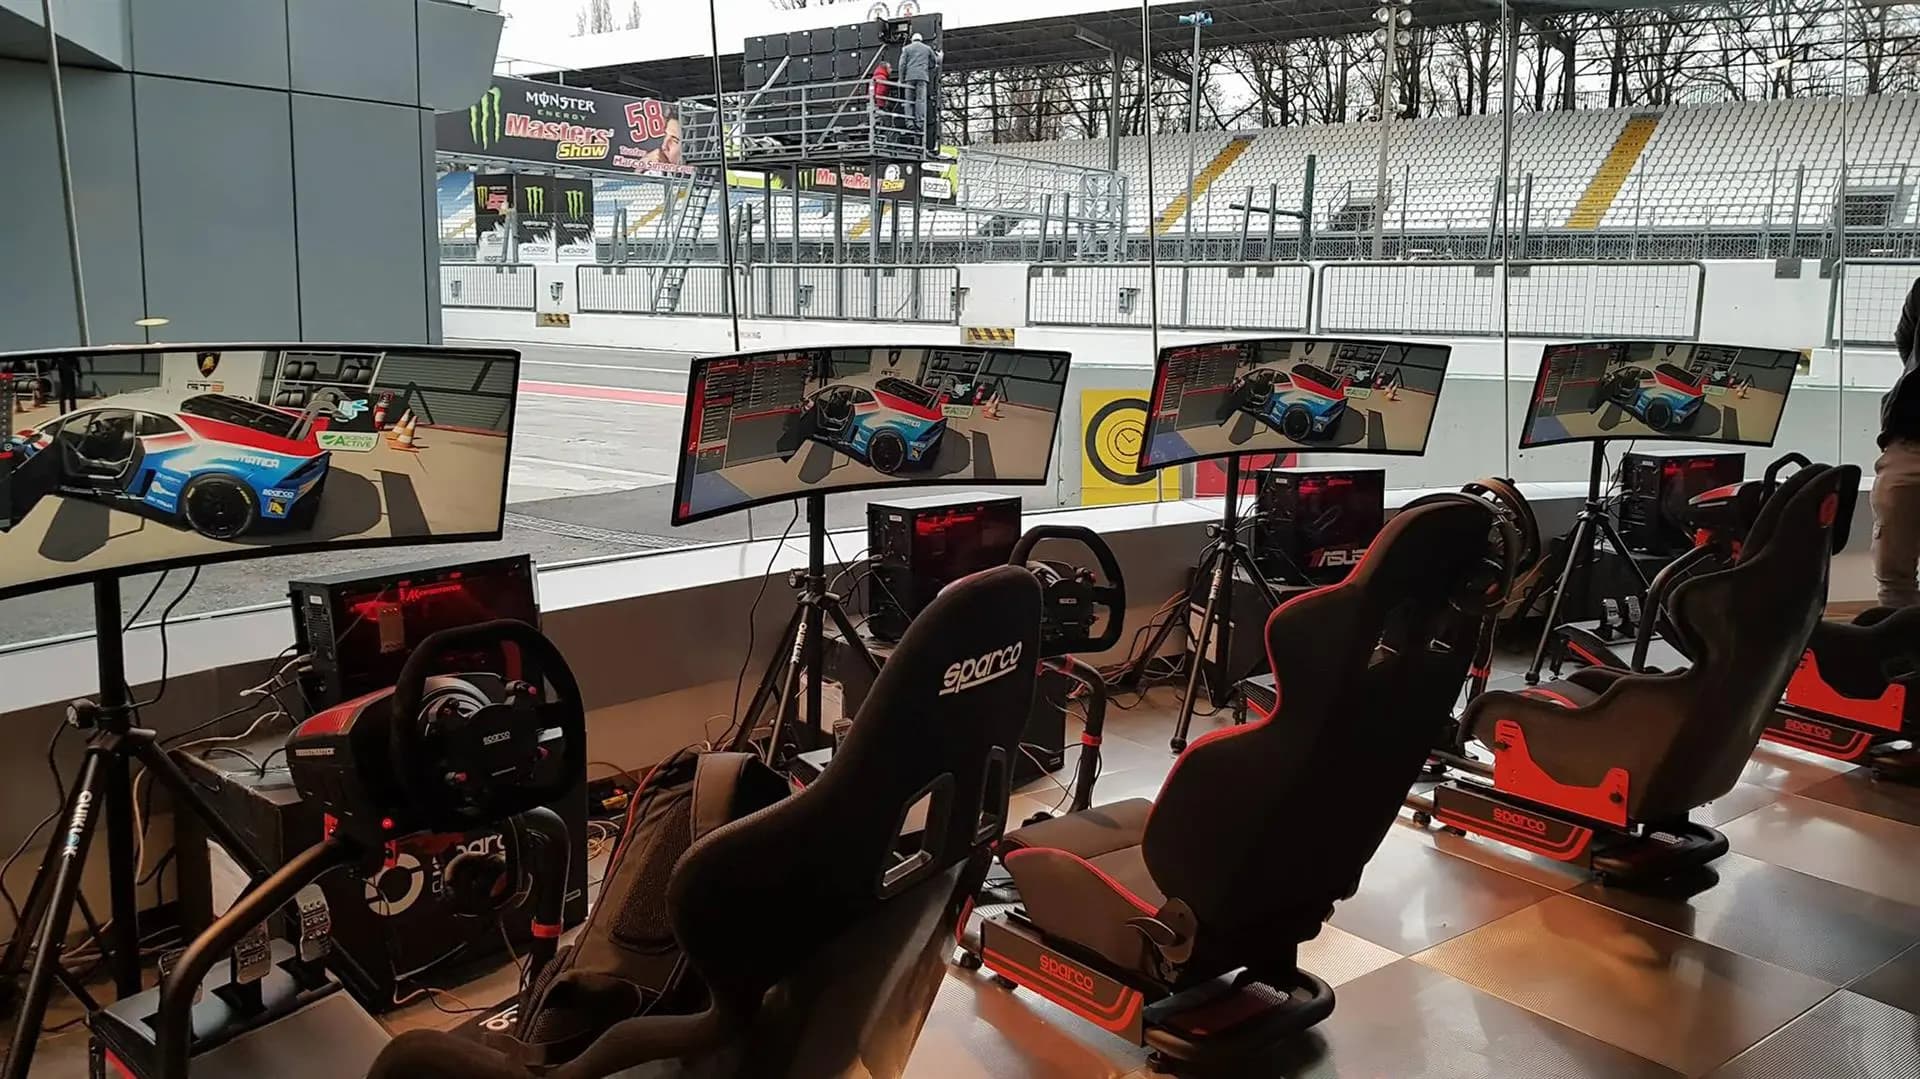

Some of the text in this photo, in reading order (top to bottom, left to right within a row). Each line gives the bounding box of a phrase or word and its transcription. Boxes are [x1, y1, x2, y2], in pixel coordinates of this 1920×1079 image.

[526, 91, 596, 114] MONSTER
[537, 109, 587, 121] ENERGY
[624, 98, 666, 142] 58
[558, 142, 607, 158] Show
[613, 155, 644, 169] Marco
[1318, 549, 1368, 567] ASUS
[940, 641, 1023, 694] sparco
[483, 731, 510, 745] sparco
[1785, 719, 1831, 739] sparco
[1494, 808, 1546, 835] sparco
[1040, 955, 1094, 993] sparco
